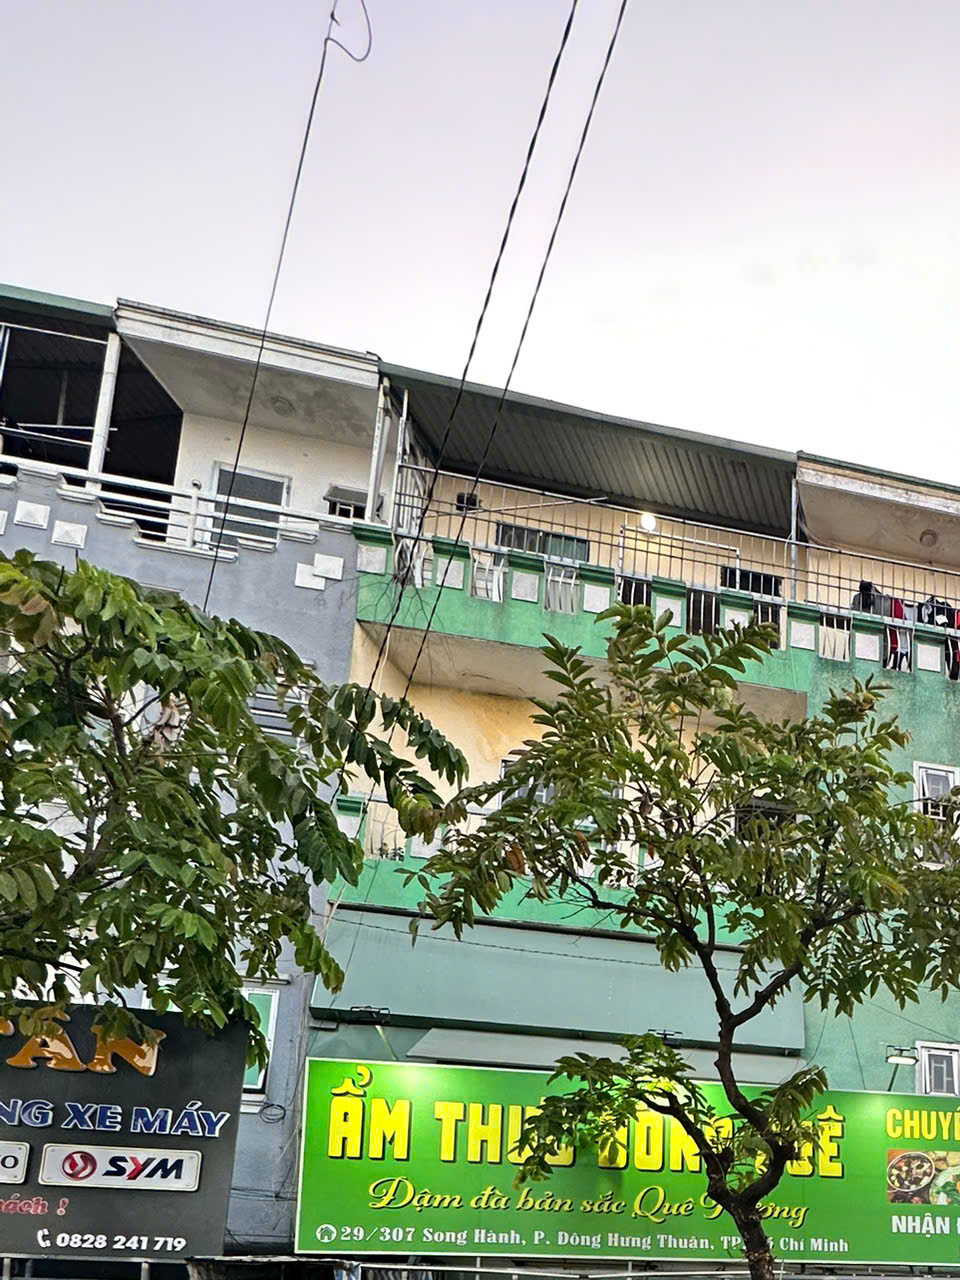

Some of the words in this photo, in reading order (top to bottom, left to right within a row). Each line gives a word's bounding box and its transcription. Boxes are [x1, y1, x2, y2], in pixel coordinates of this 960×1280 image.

[61, 1102, 122, 1131] XE
[130, 1101, 230, 1138] MÁY
[328, 1065, 411, 1160] ẨM
[102, 1155, 184, 1181] SYM
[0, 1193, 48, 1215] ách
[470, 1186, 510, 1211] đà
[517, 1187, 574, 1212] bản
[580, 1190, 627, 1214] sắc
[632, 1185, 695, 1224] Quê
[891, 1212, 951, 1238] NHẬN
[56, 1233, 107, 1248] 0828
[112, 1236, 147, 1250] 241
[152, 1237, 186, 1252] 719
[340, 1226, 416, 1242] 29/307
[423, 1228, 468, 1246] Song
[474, 1228, 527, 1246] Hành,
[533, 1230, 551, 1246] P.
[607, 1233, 652, 1251] Hưng
[657, 1234, 715, 1251] Thuận,
[779, 1237, 804, 1251] Chí
[810, 1237, 849, 1252] Minh
